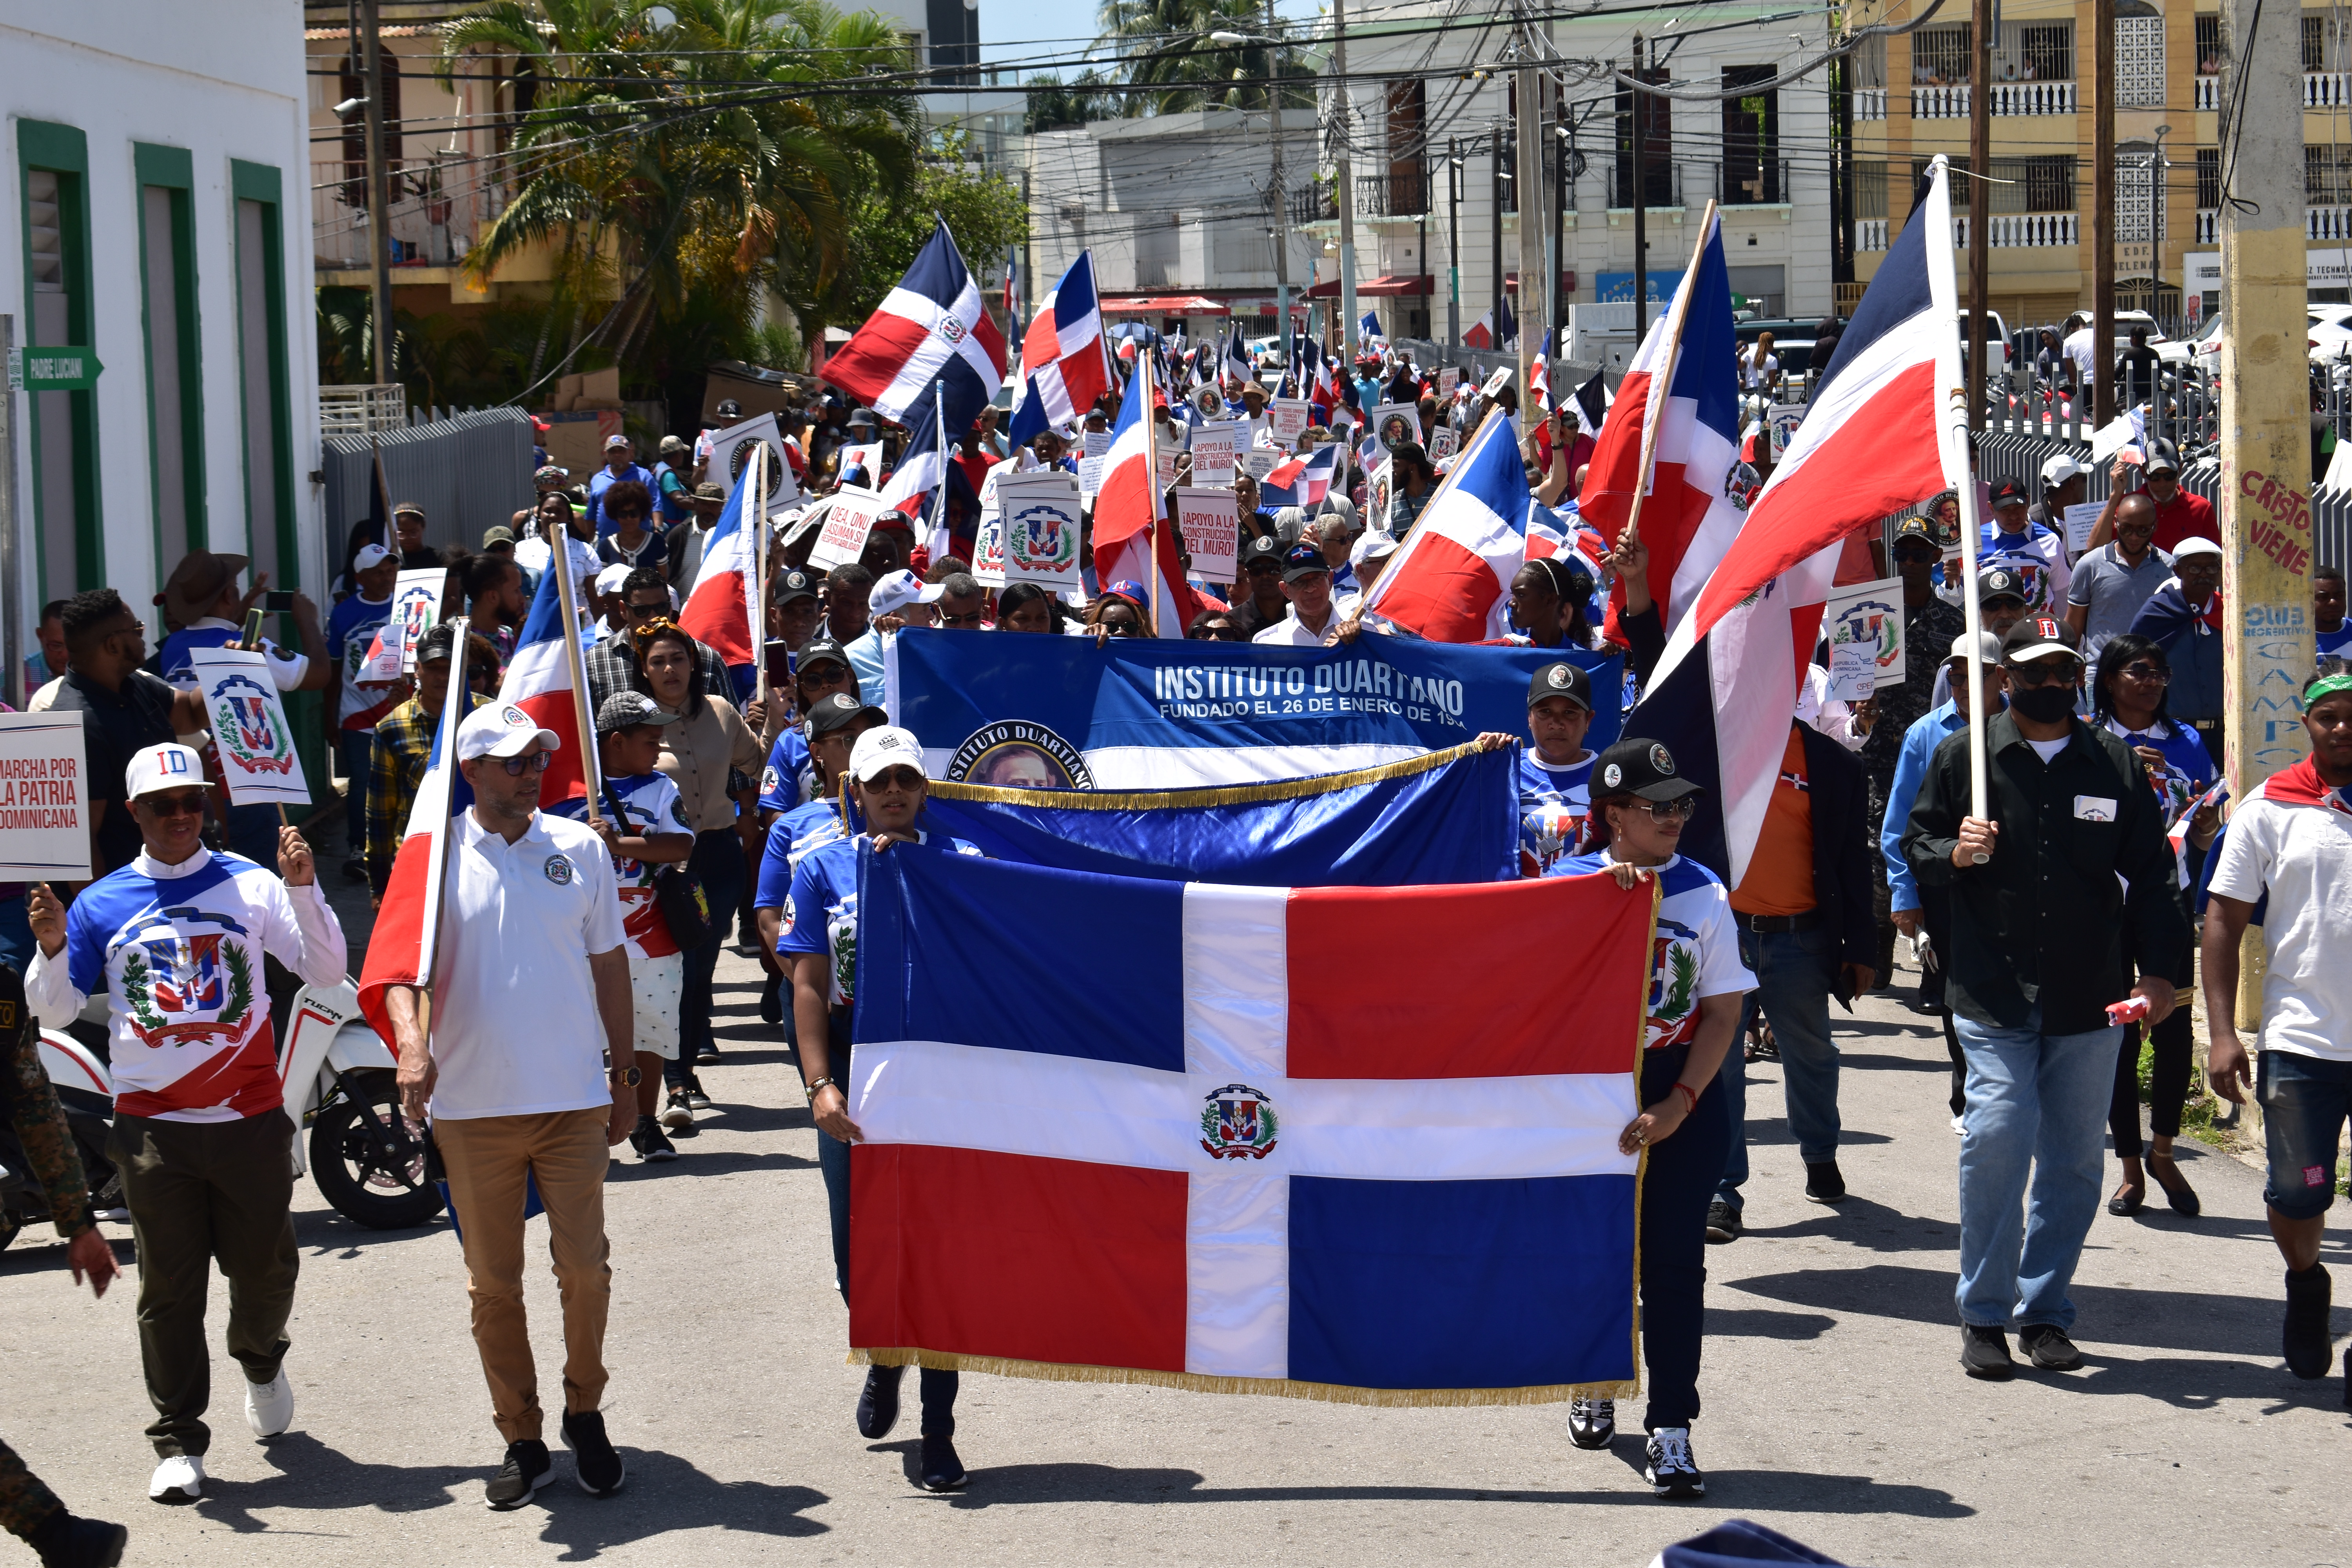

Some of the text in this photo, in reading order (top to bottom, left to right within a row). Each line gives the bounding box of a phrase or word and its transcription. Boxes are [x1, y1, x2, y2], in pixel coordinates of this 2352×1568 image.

[1602, 292, 1659, 303] Lotea
[30, 358, 83, 379] PADRE LUCIANI
[1380, 415, 1411, 432] INSTITUTO DUARTIANO
[1194, 441, 1232, 452] ¡APOYO A LA
[1194, 450, 1233, 461] CONSTRUCCIÓN
[731, 443, 745, 473] INSTITUTO
[1195, 459, 1233, 470] DEL MURO!
[767, 474, 781, 499] OMINICANA
[1926, 494, 1944, 517] NSTITUTO
[831, 506, 849, 526] OEA,
[850, 512, 871, 530] ONU
[1183, 512, 1235, 528] ¡APOYO A LA
[1902, 517, 1927, 532] POLICIA NACIONAL
[820, 534, 861, 552] RESPONSABILIDAD!
[824, 522, 865, 544] ¡ASUMAN SU
[1183, 526, 1235, 541] CONSTRUCCIÓN
[1184, 538, 1234, 557] DEL MURO!
[2250, 519, 2309, 576] VIENE
[1156, 659, 1463, 716] INSTITUTO DUARTIANO
[1160, 701, 1249, 718] FUNDADO
[1255, 701, 1277, 714] EL
[1282, 699, 1303, 713] 26
[1309, 698, 1333, 711] DE
[1339, 697, 1402, 715] ENERO
[1407, 706, 1431, 722] DE
[157, 750, 187, 775] ID
[949, 725, 1092, 789] STITUTO DUARTIANO
[51, 758, 76, 778] POR
[20, 780, 76, 806] PATRIA
[138, 920, 155, 929] DIOS
[201, 914, 232, 925] LIBERTAD
[304, 997, 343, 1020] TUCAN
[154, 1024, 233, 1038] REPUBLICA DOMINICANA
